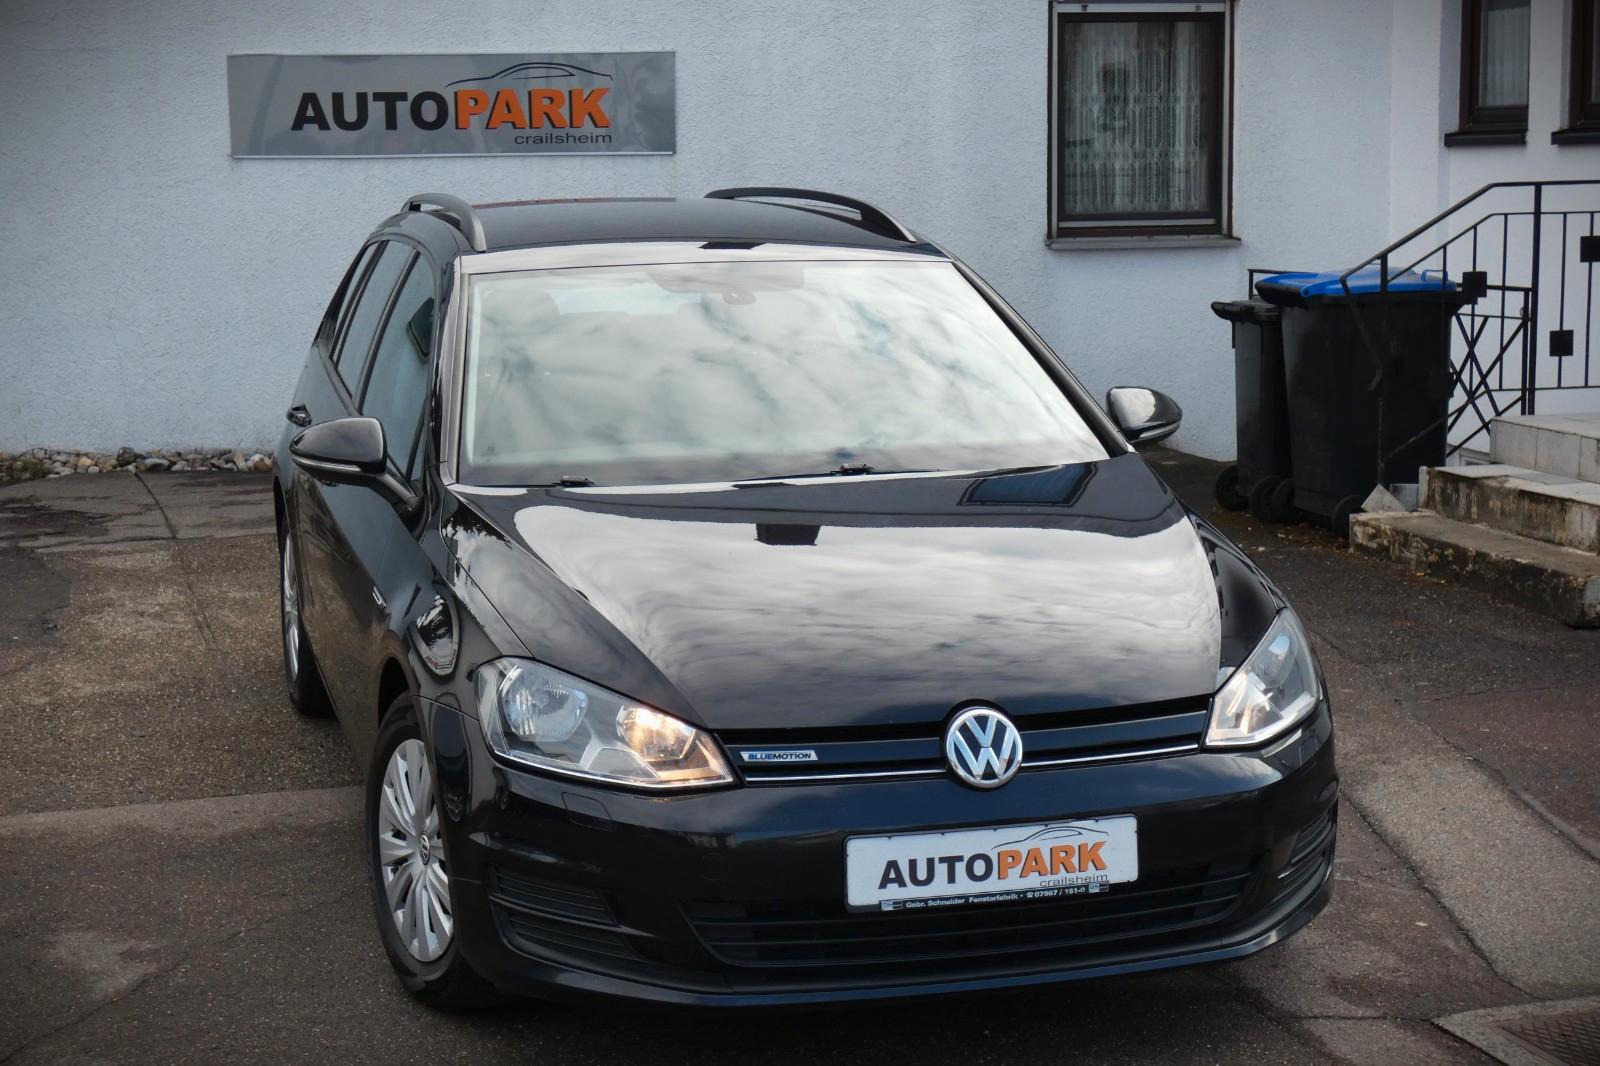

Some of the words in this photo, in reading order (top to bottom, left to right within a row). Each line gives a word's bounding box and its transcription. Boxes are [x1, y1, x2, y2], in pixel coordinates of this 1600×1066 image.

[291, 87, 611, 131] AUTOPARK
[514, 132, 612, 145] crailsheim
[748, 752, 811, 760] BLUEMOTION
[878, 840, 1108, 890] AUTOPARK
[1039, 872, 1108, 888] crailsheim
[927, 898, 965, 907] Schneider
